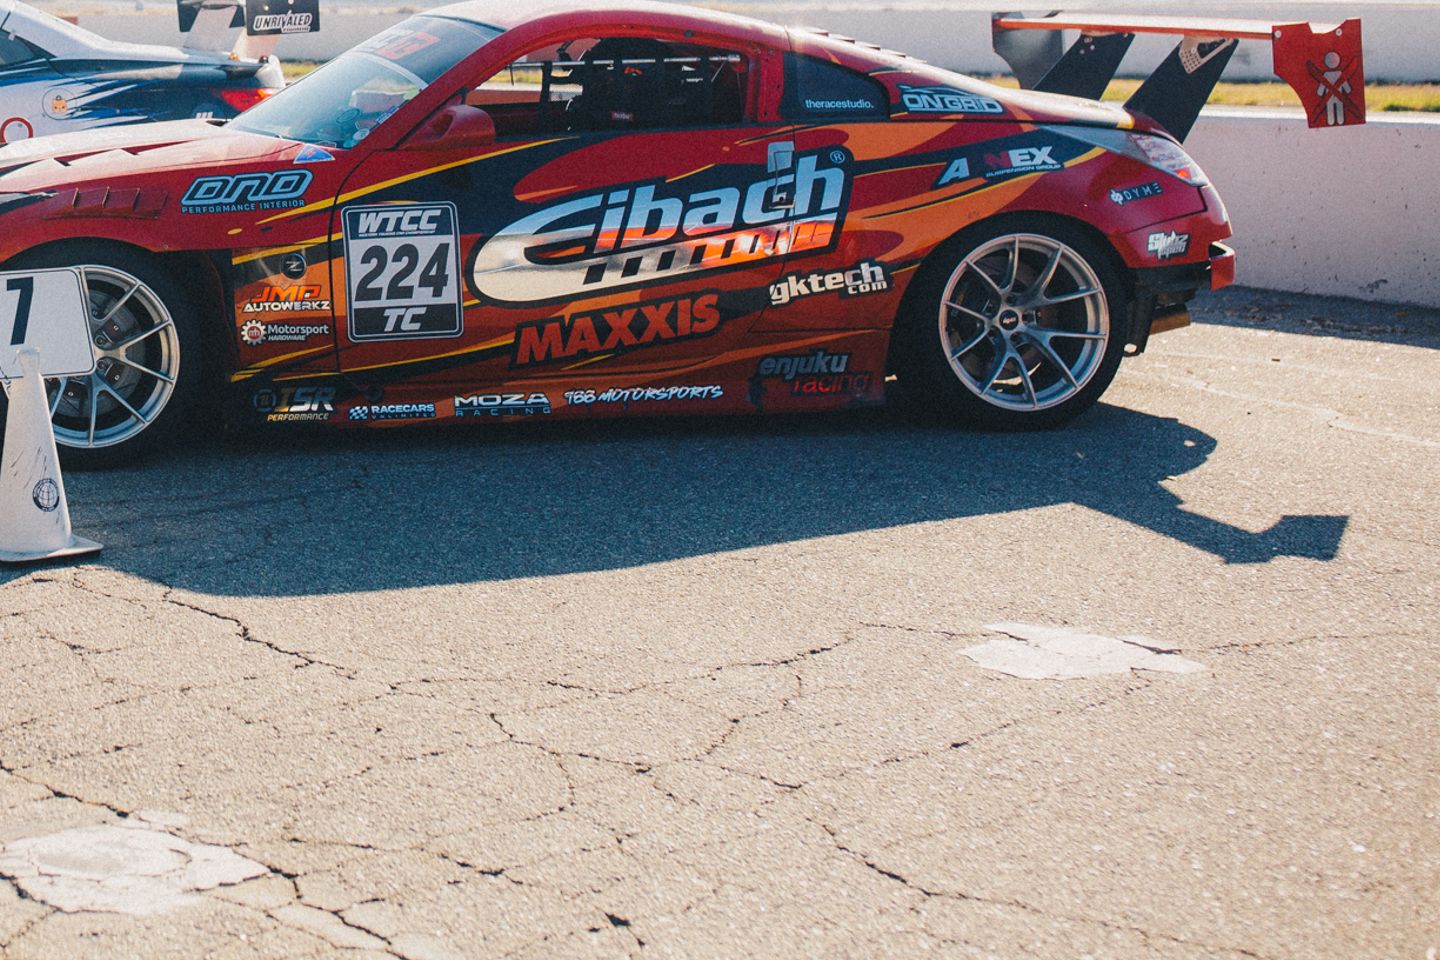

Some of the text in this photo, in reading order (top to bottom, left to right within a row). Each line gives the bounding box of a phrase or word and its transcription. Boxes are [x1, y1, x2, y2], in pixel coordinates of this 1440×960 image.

[254, 13, 310, 28] UNRIVALED
[182, 199, 305, 214] PERFORMANCE INTERIOR
[358, 209, 441, 234] WTCC
[474, 152, 844, 302] Eibach
[354, 243, 450, 301] 224
[769, 262, 884, 305] gktech
[848, 281, 888, 295] com
[251, 285, 321, 303] JMP
[7, 277, 34, 345] 7
[243, 301, 331, 313] AUTOWERKZ
[383, 306, 427, 332] TC
[268, 324, 329, 336] Motorsport
[516, 294, 720, 365] MAXXIS
[761, 351, 848, 380] enjuku
[454, 392, 550, 407] MOZA
[597, 385, 724, 402] MOTORSPORTS
[267, 412, 329, 422] PERFORMANCE
[371, 404, 435, 414] RACECARS
[455, 407, 551, 416] RACING
